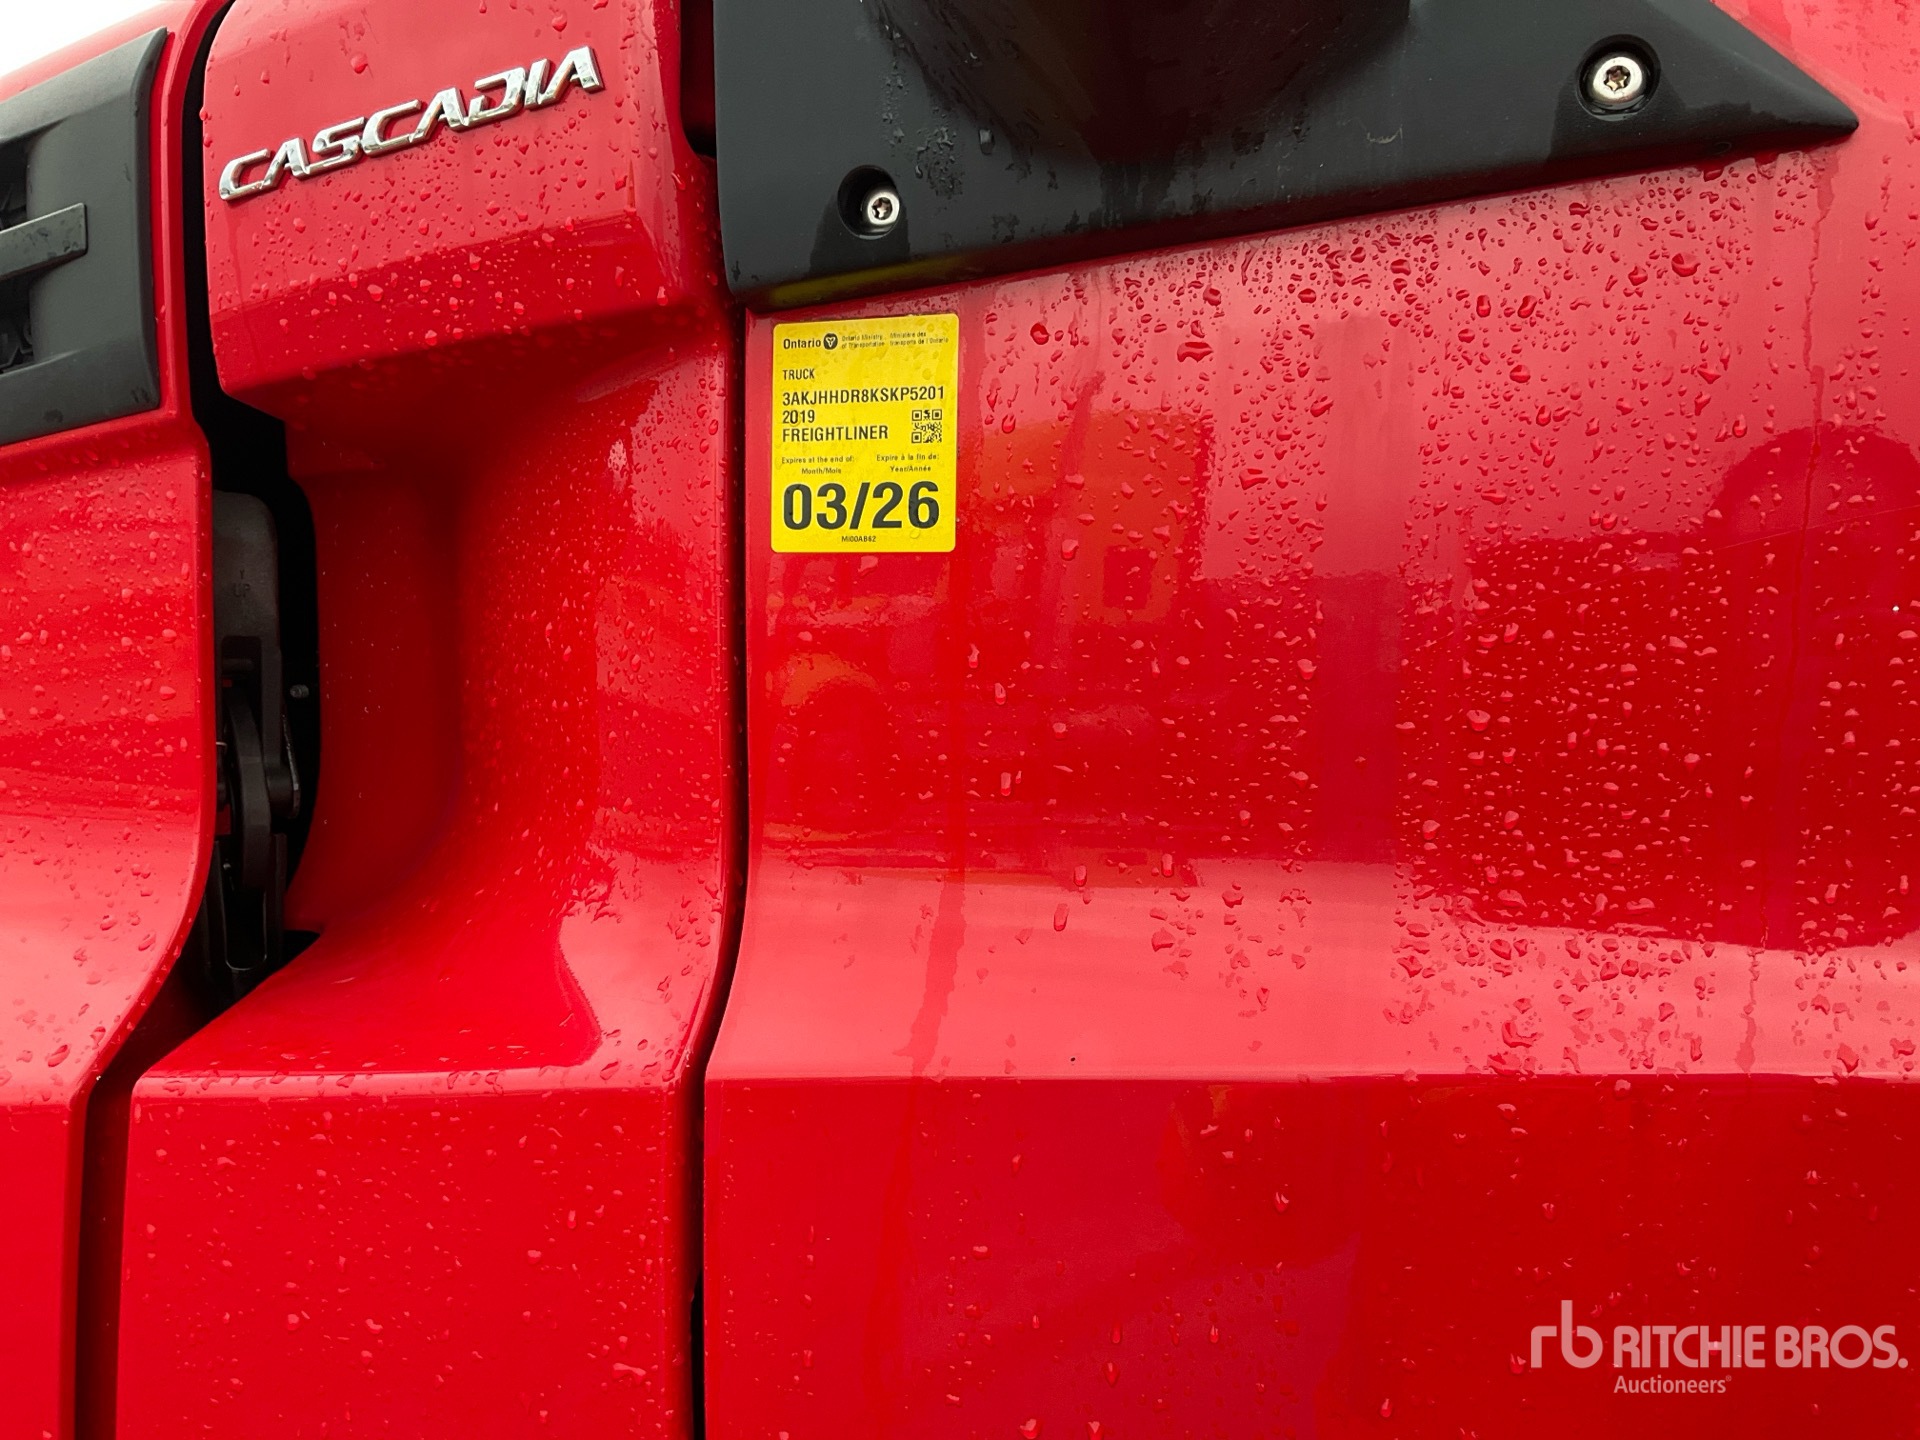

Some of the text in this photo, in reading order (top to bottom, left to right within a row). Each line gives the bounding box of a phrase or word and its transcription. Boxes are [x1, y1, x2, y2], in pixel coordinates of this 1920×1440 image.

[219, 46, 604, 201] CASCADIA
[783, 338, 821, 350] Ontario
[782, 368, 815, 380] TRUCK
[782, 386, 944, 406] 3AKJHHDR8KSKP5201
[782, 410, 815, 424] 2019
[782, 425, 889, 442] FREIGHTLINER
[782, 456, 806, 465] Expires
[876, 454, 898, 462] Expire
[900, 453, 905, 461] à
[801, 467, 842, 475] Month/Mois
[890, 465, 931, 473] Year/Année
[784, 481, 940, 530] 03/26
